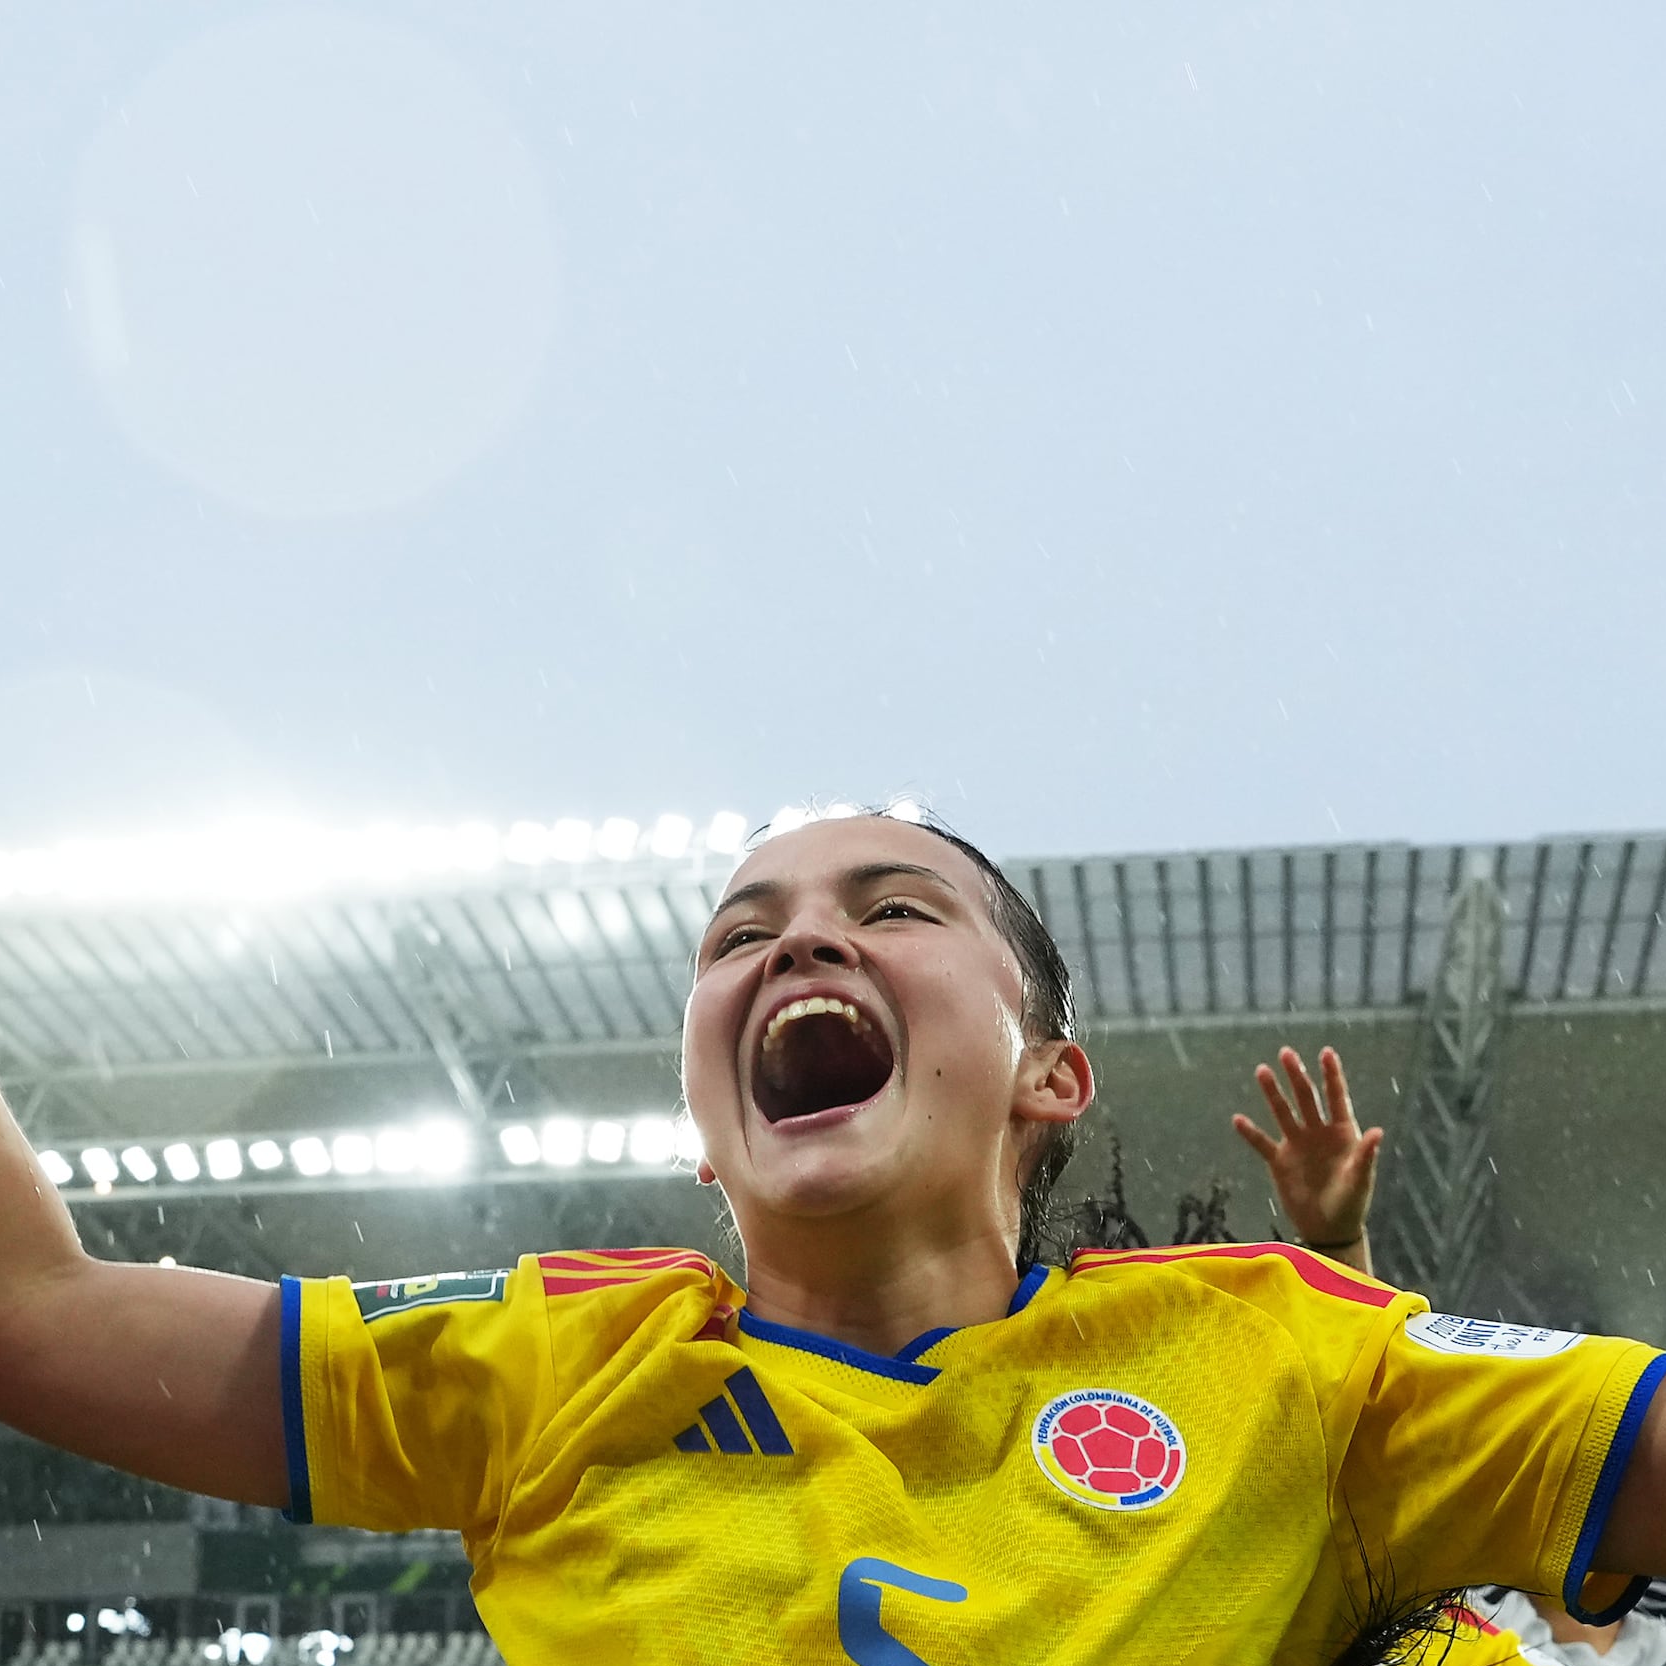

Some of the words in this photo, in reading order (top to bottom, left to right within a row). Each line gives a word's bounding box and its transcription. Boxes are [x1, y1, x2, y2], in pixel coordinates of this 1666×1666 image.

[1425, 1315, 1465, 1339] FOOTB
[1451, 1320, 1501, 1348] UNIT
[1069, 1391, 1140, 1409] COLOMBIANA
[1139, 1404, 1154, 1417] DE
